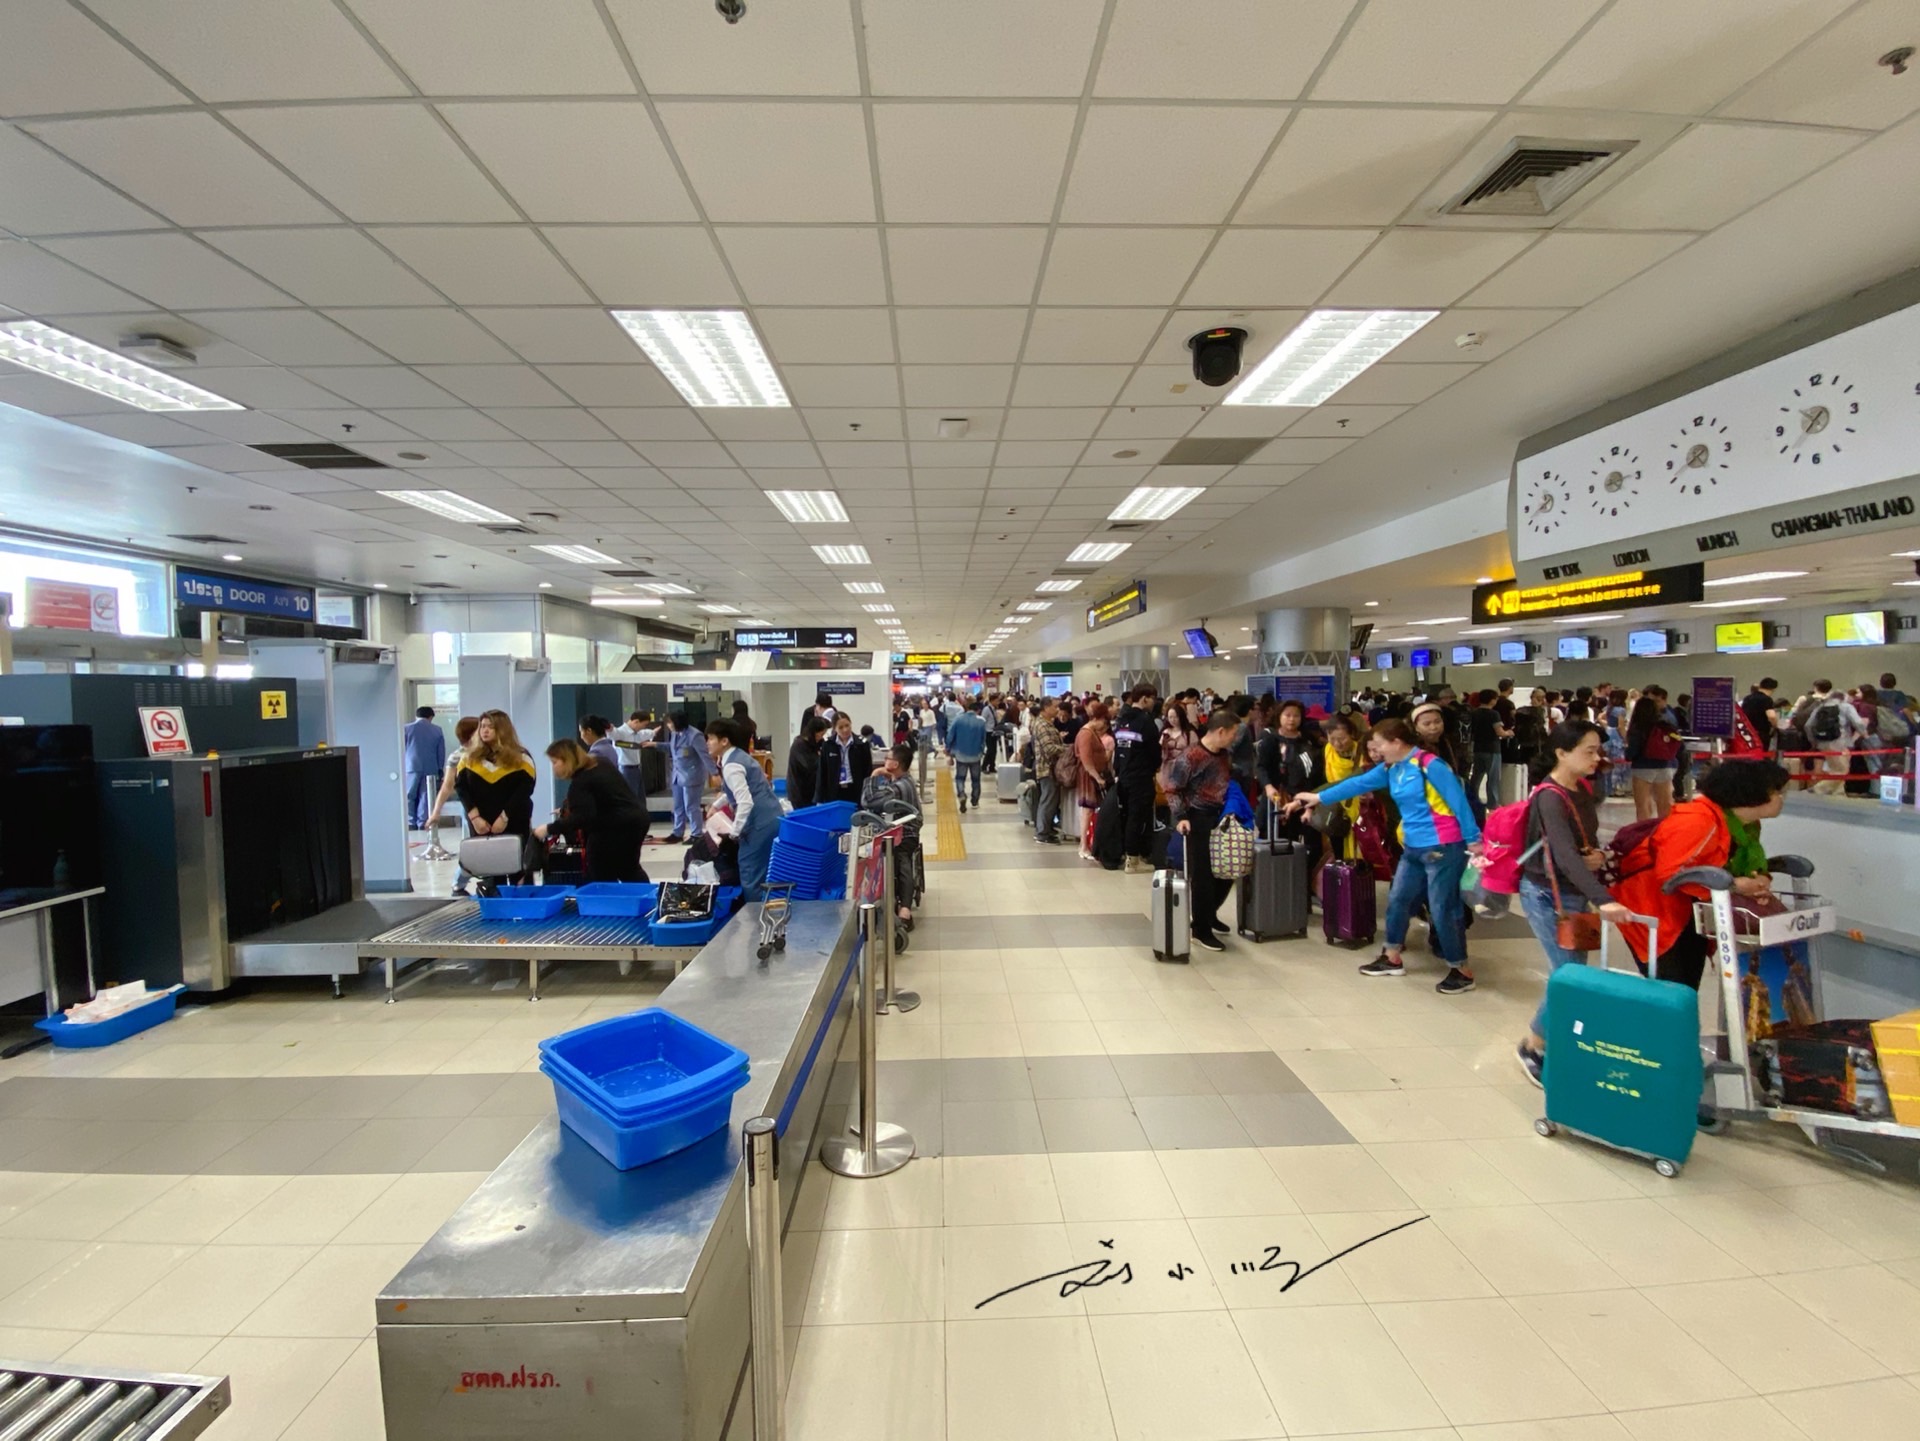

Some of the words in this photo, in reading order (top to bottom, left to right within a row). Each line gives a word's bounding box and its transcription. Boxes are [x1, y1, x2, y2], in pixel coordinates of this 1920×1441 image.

[1809, 373, 1822, 387] 12
[1850, 402, 1859, 414] 3
[1693, 416, 1704, 427] 12
[1776, 425, 1784, 437] 9
[1724, 442, 1732, 452] 3
[1666, 460, 1674, 470] 9
[1812, 453, 1821, 465] 6
[1635, 471, 1641, 480] 3
[1589, 485, 1595, 494] 9
[1694, 485, 1701, 495] 6
[1611, 508, 1618, 517] 6
[1771, 495, 1915, 538] CHIANGMAI-THAILAND
[1544, 525, 1550, 534] 6
[1696, 530, 1739, 552] MUNICH
[1612, 548, 1651, 567] LONDON
[1542, 566, 1560, 580] NEW
[1560, 562, 1582, 577] YORK
[183, 579, 223, 605] ประตู
[230, 588, 266, 605] DOOR
[294, 596, 310, 612] 10
[1777, 626, 1788, 637] 10
[1796, 912, 1820, 931] Gulf
[1576, 1041, 1595, 1053] The
